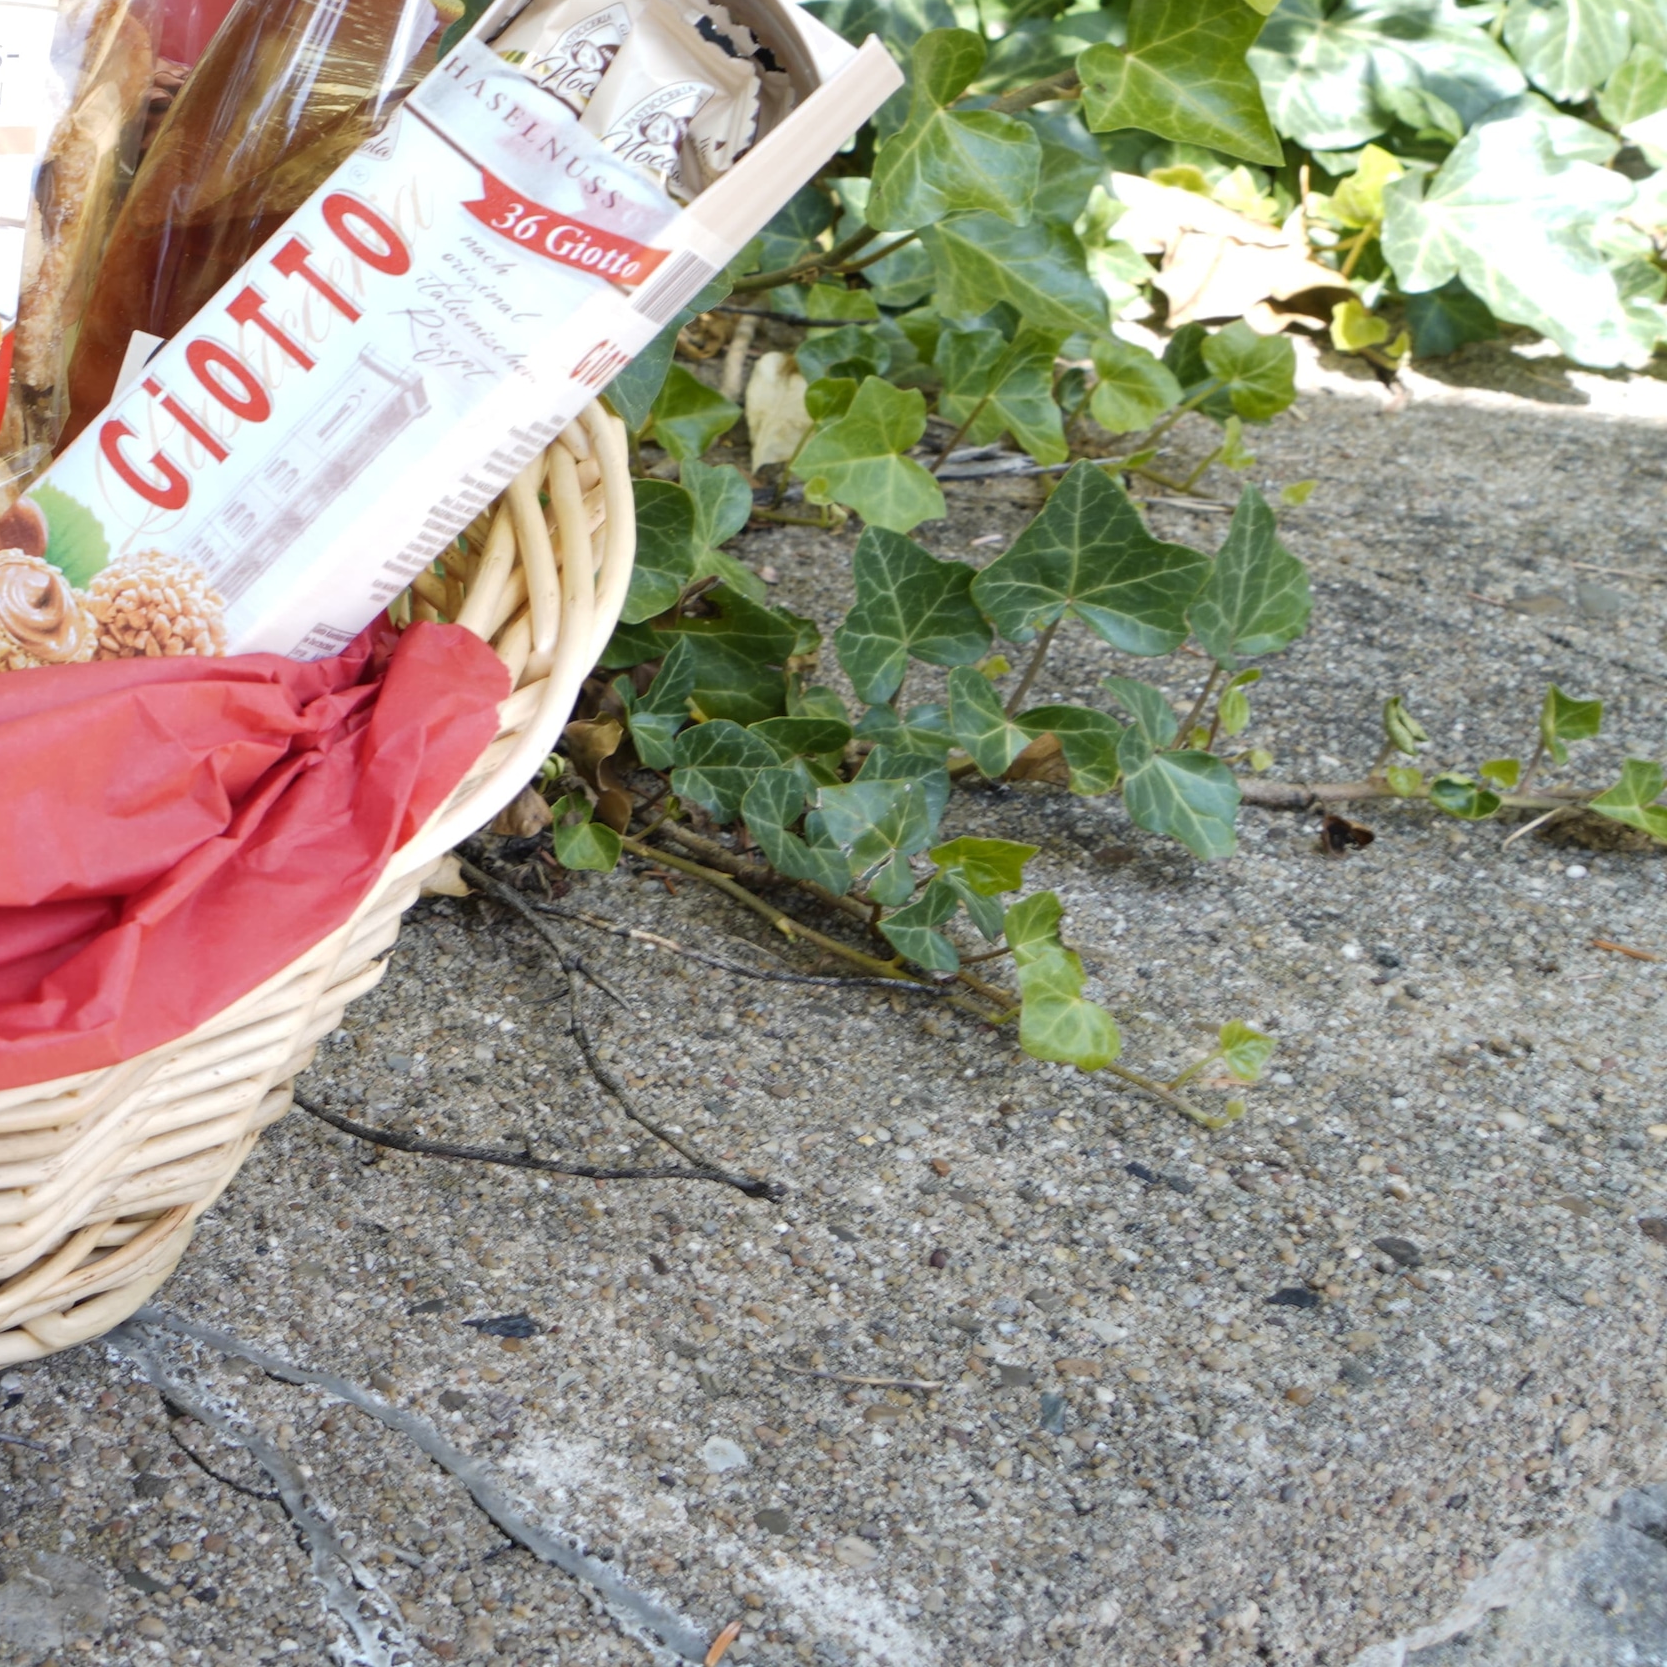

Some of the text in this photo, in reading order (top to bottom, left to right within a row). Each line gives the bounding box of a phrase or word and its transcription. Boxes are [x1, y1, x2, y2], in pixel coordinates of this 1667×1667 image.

[443, 56, 624, 210] HASELNUSS
[624, 85, 697, 130] PASTICCERIA
[459, 235, 517, 276] nach
[490, 203, 642, 279] 36 Giotto
[441, 252, 542, 322] original
[387, 308, 496, 380] Rezept
